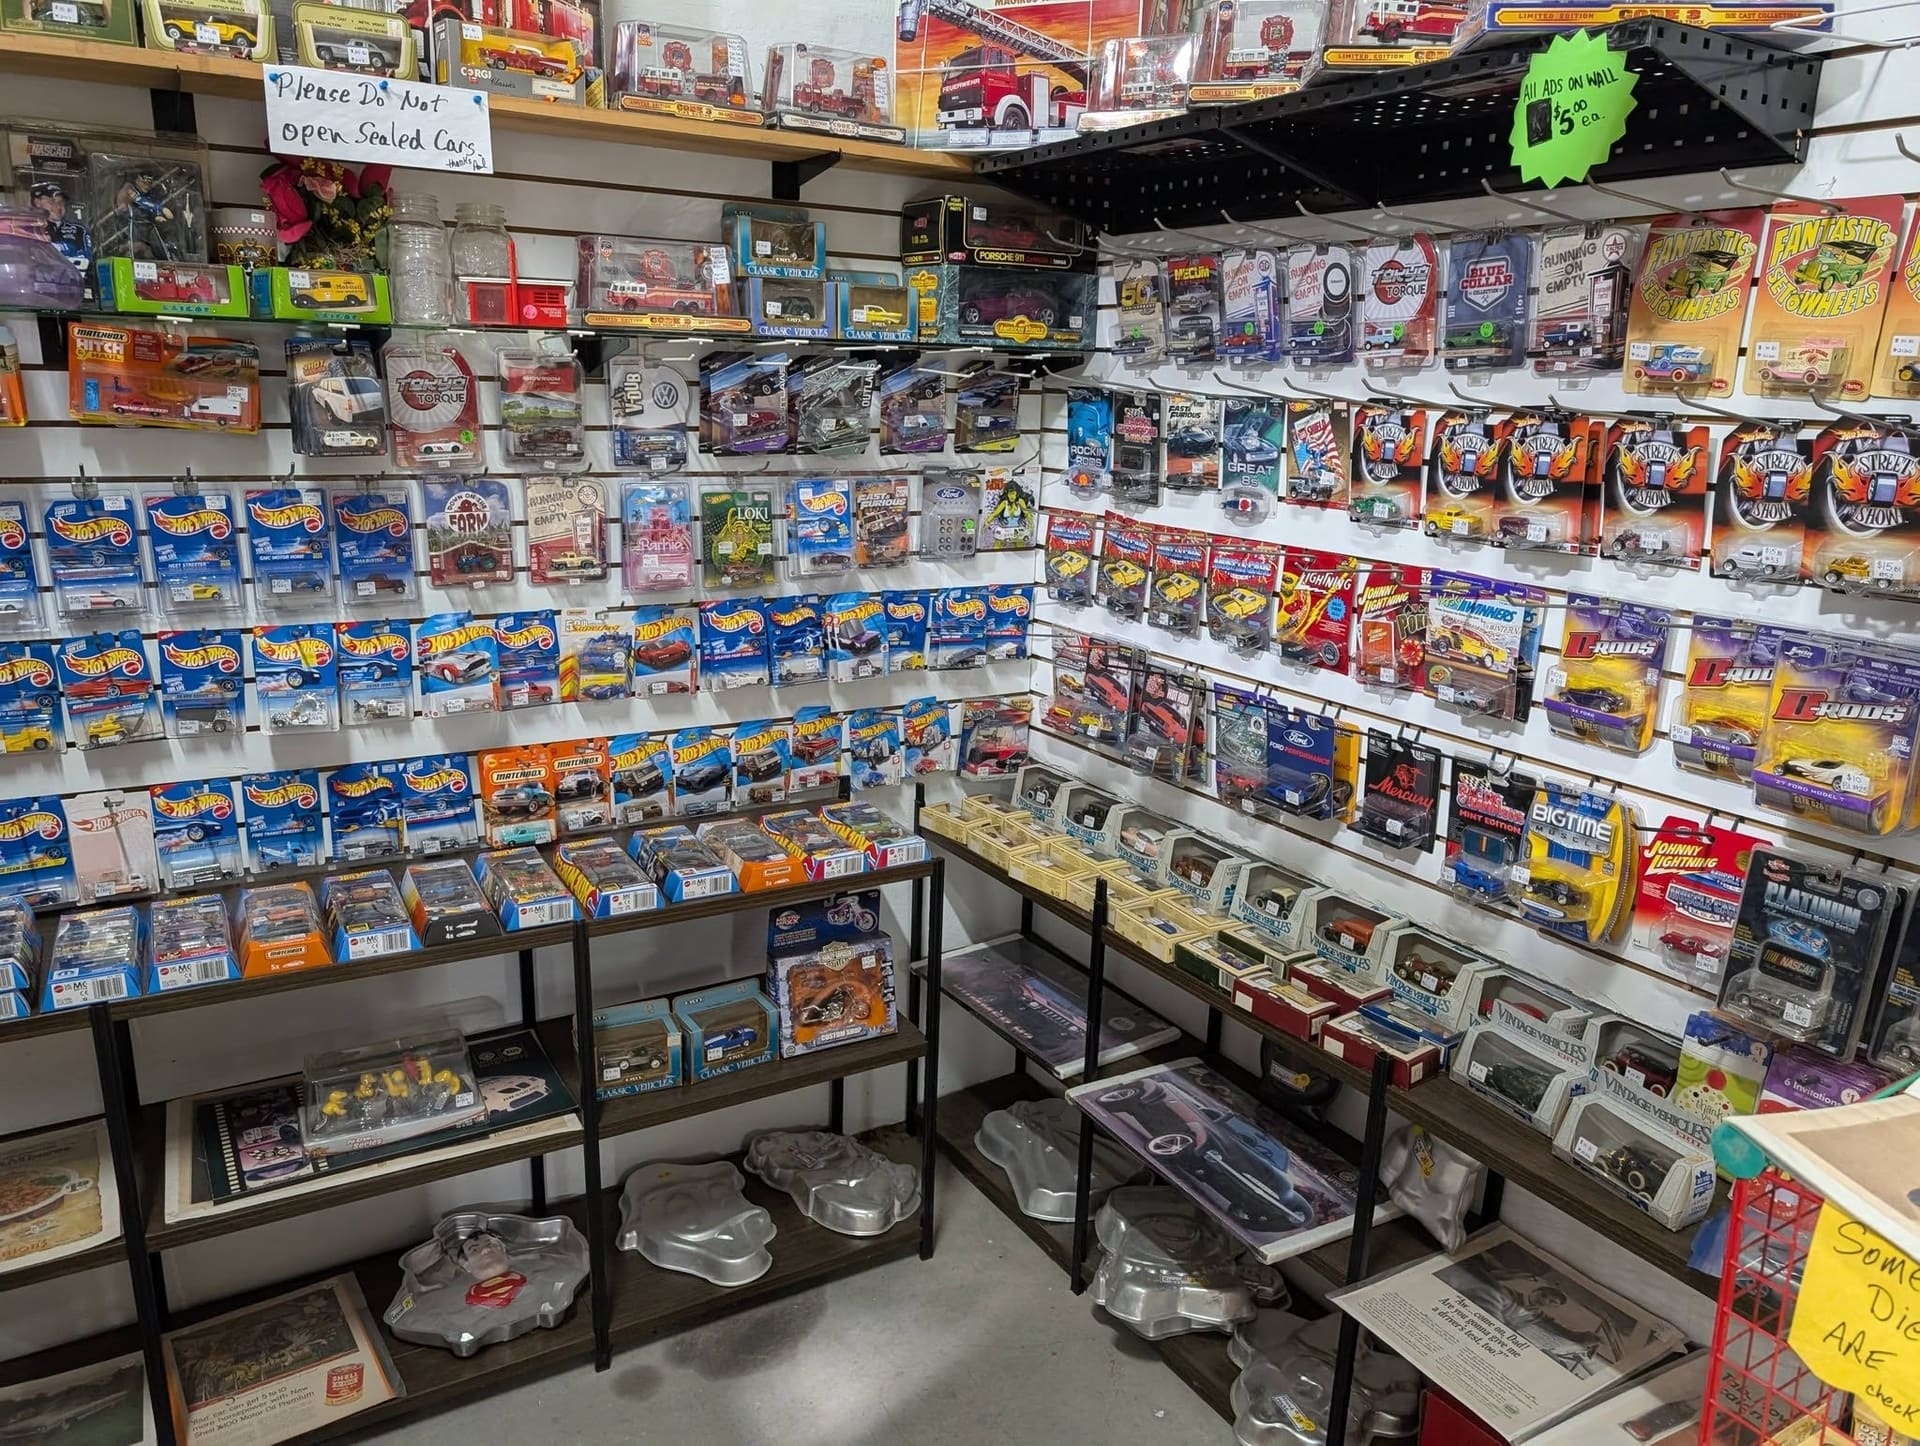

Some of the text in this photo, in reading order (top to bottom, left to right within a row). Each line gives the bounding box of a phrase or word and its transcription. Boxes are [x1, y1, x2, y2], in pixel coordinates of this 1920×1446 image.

[1373, 52, 1405, 60] EDITION
[460, 66, 492, 79] CORGI
[1542, 77, 1563, 95] ADS
[1568, 77, 1584, 89] ON
[1587, 67, 1619, 87] WALL
[277, 71, 448, 113] Please Do Not
[942, 78, 981, 93] FEUERWEHR
[1582, 113, 1605, 127] ea.
[282, 122, 349, 146] open
[355, 121, 426, 151] Sealed
[1645, 228, 1752, 274] FANTASTIC
[1769, 216, 1890, 267] FANTASTIC
[979, 250, 1025, 263] PORSCHE 911
[1543, 244, 1597, 266] RUNNING
[747, 264, 819, 279] CLASSIC VEHICLES
[1174, 266, 1210, 280] MECUM
[1224, 263, 1255, 282] RUNNING
[1290, 259, 1327, 278] RUNNING
[1371, 266, 1431, 285] TOKYO
[1469, 264, 1505, 277] BLUE
[1564, 262, 1583, 275] ON
[1387, 283, 1426, 297] TORQUE
[1460, 273, 1514, 290] COLLAR
[1545, 275, 1586, 295] EMPTY
[1228, 286, 1251, 302] EMPTY
[1294, 285, 1321, 301] EMPTY
[76, 327, 126, 341] MATCHBOX
[758, 326, 829, 338] CLASSIC VEHICLES
[846, 330, 912, 341] CLASSIC VEHICLES
[396, 375, 468, 393] TOKYO
[417, 392, 465, 404] TORQUE
[623, 372, 644, 418] V-DUB
[1376, 425, 1404, 441] STREET
[1455, 436, 1486, 451] STREET
[1527, 436, 1562, 453] STREET
[1637, 445, 1677, 463] STREET
[1754, 453, 1801, 472] STREET
[1227, 463, 1275, 476] GREAT
[1374, 463, 1400, 479] SHOW
[1857, 454, 1916, 475] STREET
[1453, 476, 1481, 492] SHOW
[1523, 478, 1555, 497] SHOW
[528, 489, 574, 508] RUNNING
[860, 499, 907, 509] FURIOUS
[1637, 488, 1671, 507] SHOW
[547, 502, 564, 513] ON
[737, 506, 770, 521] LOKI
[1752, 500, 1792, 522] SHOW
[1854, 504, 1903, 528] SHOW
[449, 514, 488, 533] FARM
[533, 511, 568, 526] EMPTY
[638, 537, 685, 553] Barbie
[1296, 571, 1352, 593] LIGHTNING
[1421, 572, 1432, 585] 52
[1358, 584, 1398, 605] JOHNNY
[1362, 592, 1409, 613] LIGHTNING
[1463, 600, 1518, 623] WINNERS
[1286, 730, 1311, 747] Ford
[557, 757, 600, 768] MATCHBOX
[495, 769, 543, 781] MATCHBOX
[1368, 778, 1434, 810] Mercury
[1459, 809, 1522, 836] MINT EDITION
[1532, 804, 1612, 842] BIGTIME
[1643, 840, 1703, 859] JOHNNY
[1644, 855, 1718, 876] LIGHTNING
[1764, 881, 1862, 930] PLATINUM
[1779, 955, 1817, 978] NASCAR
[1497, 1001, 1588, 1063] VINTAGE VEHICLES
[700, 1053, 771, 1081] CLASSIC VEHICLES
[1602, 1071, 1713, 1145] VINTAGE VEHICLES
[1438, 1297, 1521, 1359] Are you gonna give me
[1474, 1312, 1496, 1328] come
[1506, 1333, 1531, 1351] Dad!
[1822, 1321, 1898, 1371] ARE
[213, 1409, 226, 1419] car
[228, 1402, 245, 1412] can
[217, 1400, 268, 1424] horsepower
[267, 1392, 288, 1406] with
[290, 1385, 309, 1397] New
[1865, 1383, 1919, 1423] check
